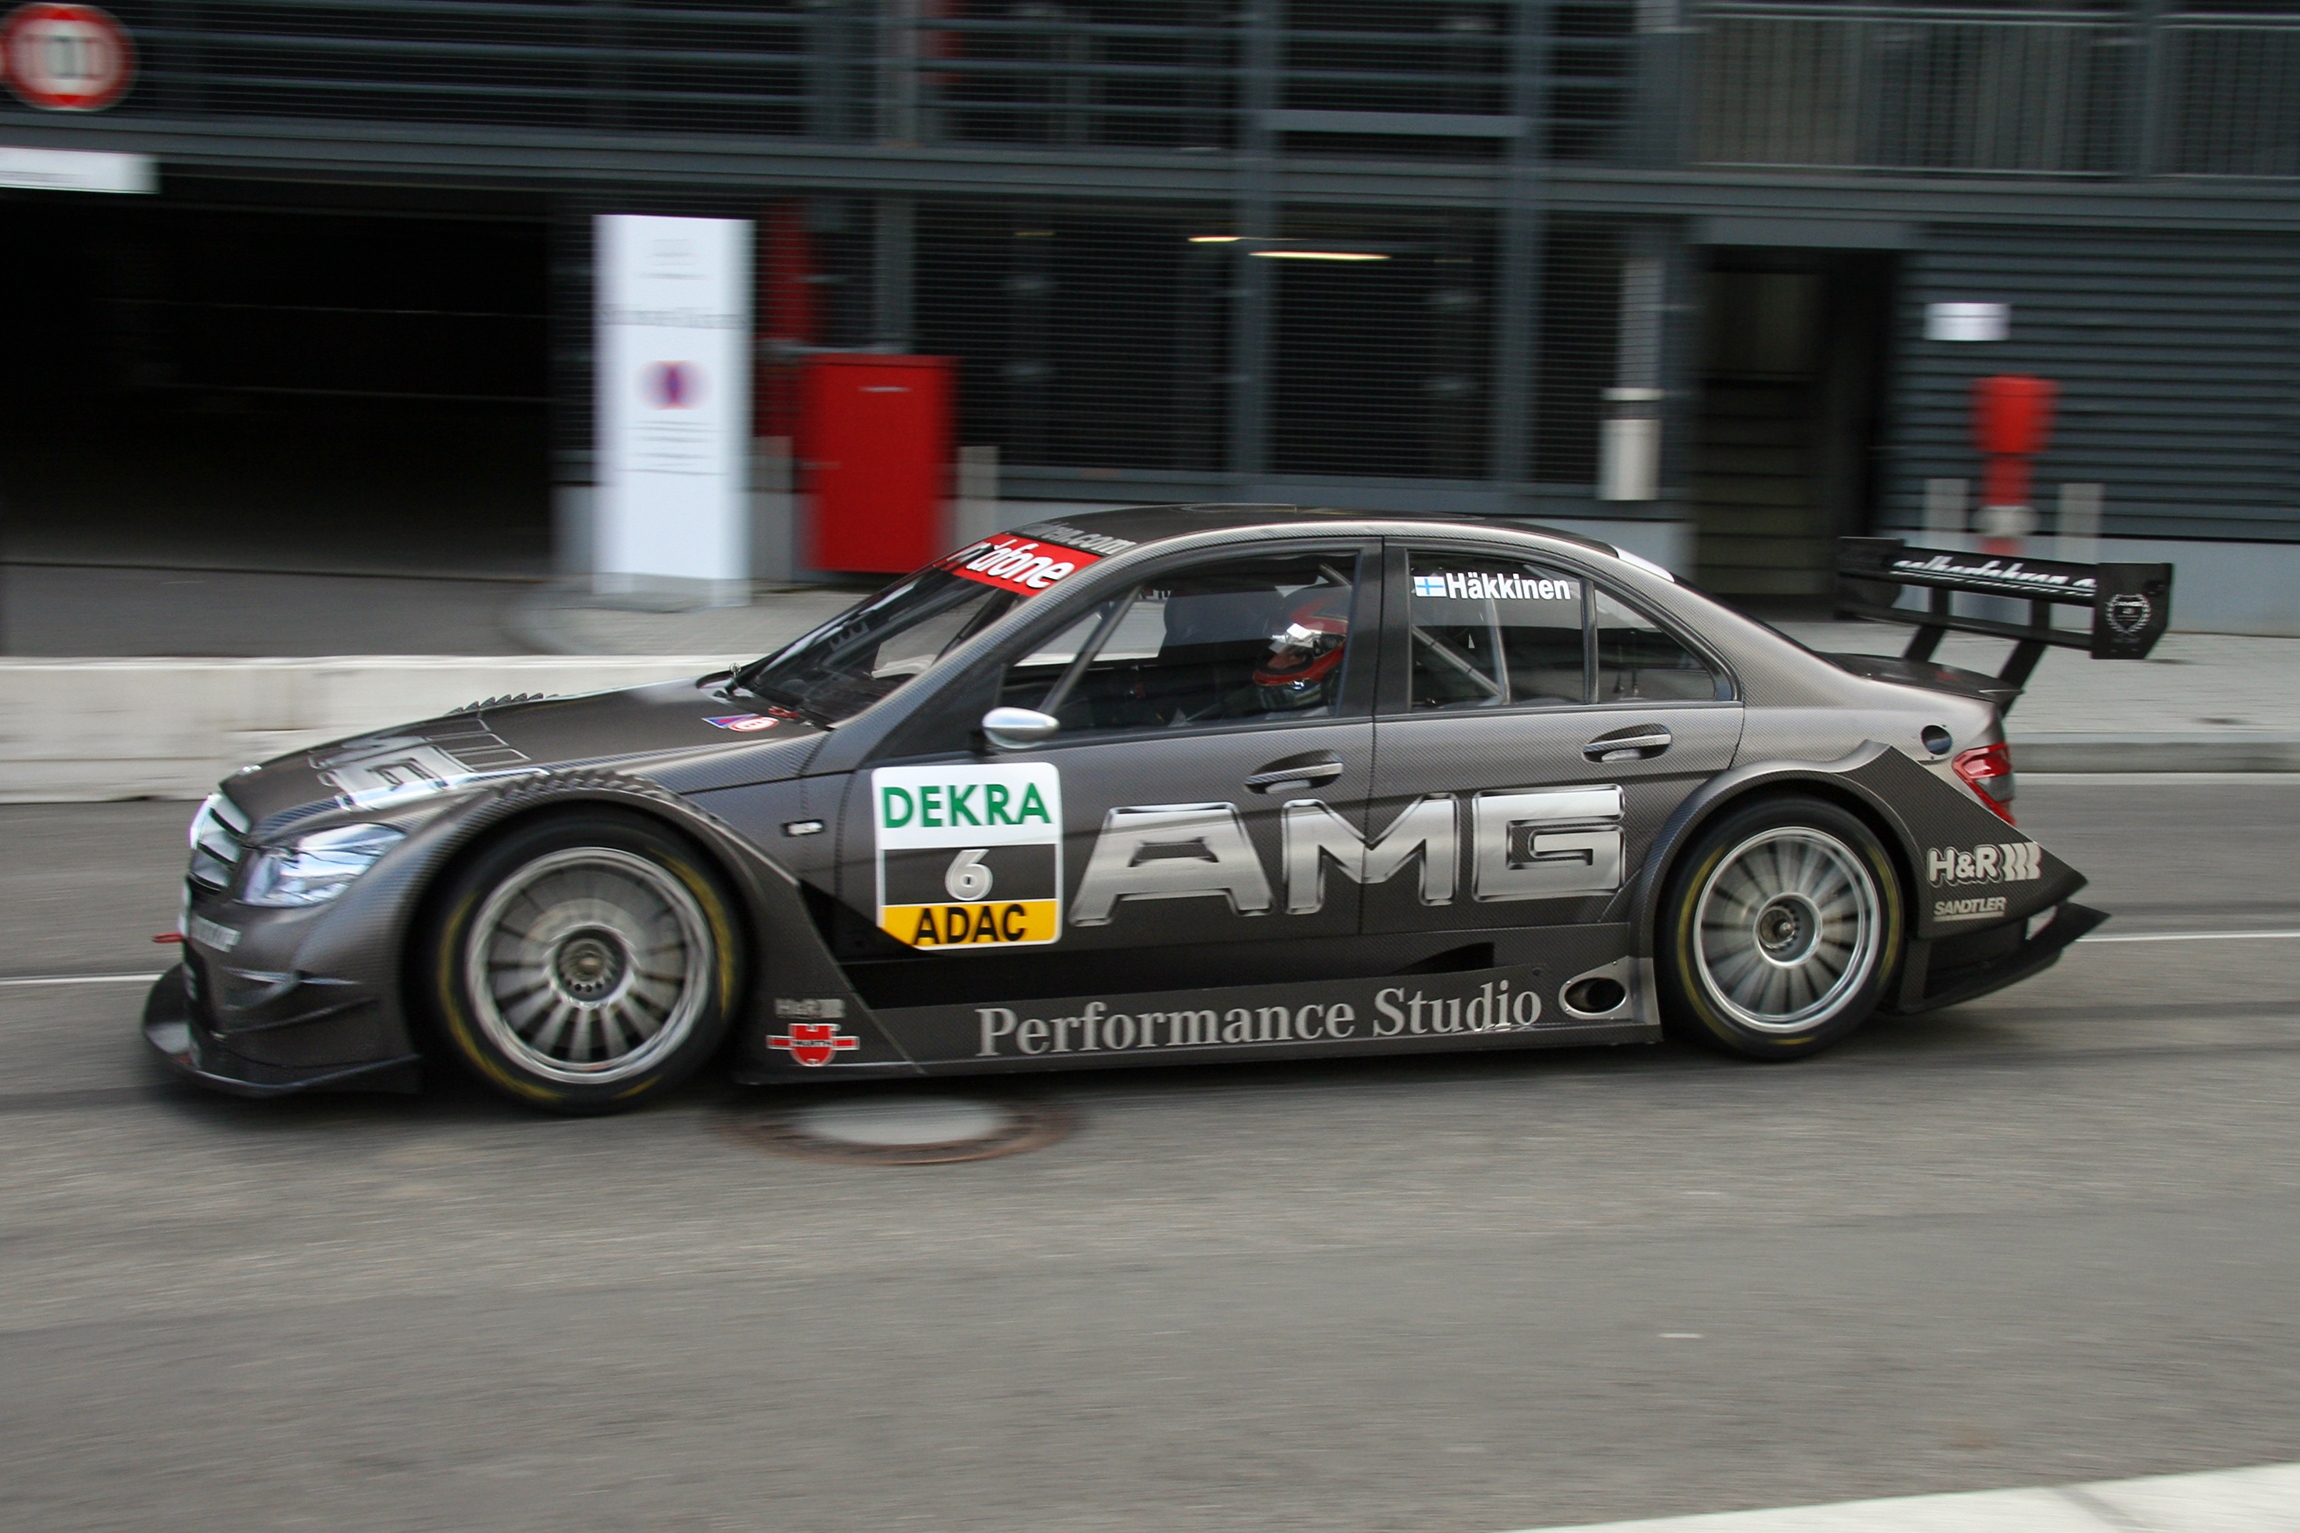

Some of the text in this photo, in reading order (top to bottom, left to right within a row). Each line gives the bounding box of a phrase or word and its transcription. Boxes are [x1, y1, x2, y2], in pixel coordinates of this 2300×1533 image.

[1446, 571, 1572, 600] Häkkinen
[880, 782, 1052, 829] DEKRA
[945, 848, 994, 902] 6
[1068, 785, 1627, 927] AMG
[1927, 844, 2002, 887] H&R
[914, 903, 1027, 946] ADAC
[1933, 897, 2008, 917] SANDTLER
[975, 979, 1542, 1058] Performance Studio
